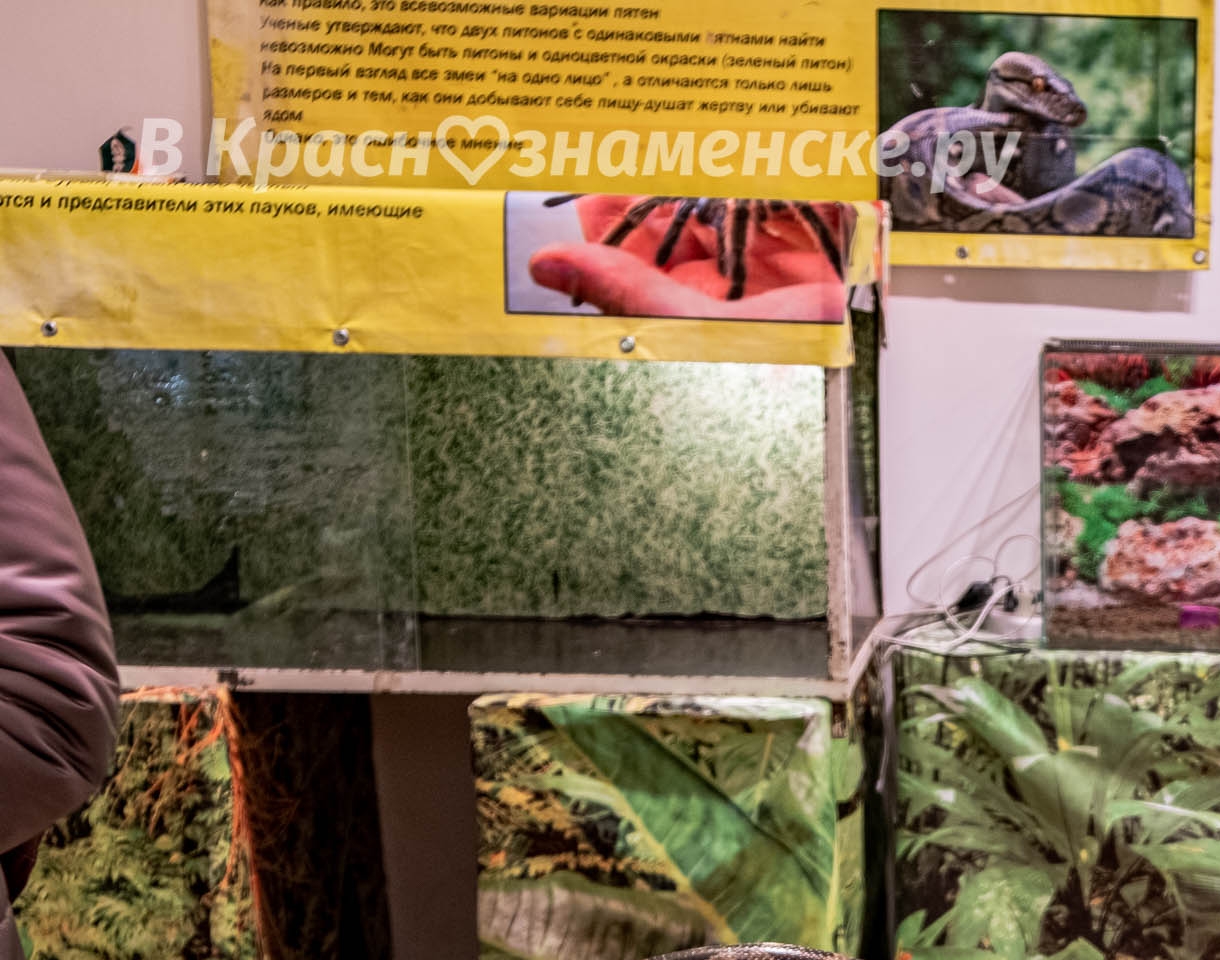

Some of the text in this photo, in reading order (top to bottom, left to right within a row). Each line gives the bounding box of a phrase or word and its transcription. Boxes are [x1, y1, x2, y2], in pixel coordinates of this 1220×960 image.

[370, 1, 395, 12] это
[400, 1, 524, 15] всевозможные
[530, 5, 608, 18] вариации
[614, 7, 660, 19] пятен
[260, 15, 321, 31] Ученые
[325, 20, 426, 37] утверждают,
[431, 24, 457, 36] что
[460, 25, 498, 40] двух
[502, 26, 569, 40] питонов
[587, 28, 701, 43] одинаковыми
[706, 32, 774, 46] ятнами
[778, 33, 827, 47] найти
[260, 40, 362, 56] невозможно
[368, 42, 414, 59] Могут
[418, 43, 457, 59] быть
[462, 48, 522, 61] питоны
[542, 49, 647, 64] одноцветной
[651, 54, 717, 67] окраски
[722, 53, 797, 69] (зеленый
[801, 56, 852, 72] питон)
[261, 61, 281, 75] На
[286, 63, 351, 79] первый
[356, 66, 407, 81] взгляд
[411, 69, 439, 81] все
[444, 69, 486, 82] змеи
[522, 71, 560, 85] одно
[637, 75, 729, 89] отличаются
[734, 78, 786, 91] только
[791, 80, 832, 92] лишь
[262, 87, 342, 102] размеров
[363, 89, 396, 104] тем,
[401, 90, 428, 104] как
[434, 92, 463, 104] они
[466, 92, 552, 107] добывают
[555, 93, 593, 108] себе
[699, 101, 753, 116] жертву
[758, 103, 786, 114] или
[791, 102, 860, 116] убивают
[263, 107, 304, 122] ядом
[460, 137, 523, 150] мнение
[40, 196, 52, 209] и
[57, 195, 198, 213] представители
[203, 199, 245, 214] этих
[249, 201, 321, 218] пауков,
[327, 202, 424, 219] имеющие
